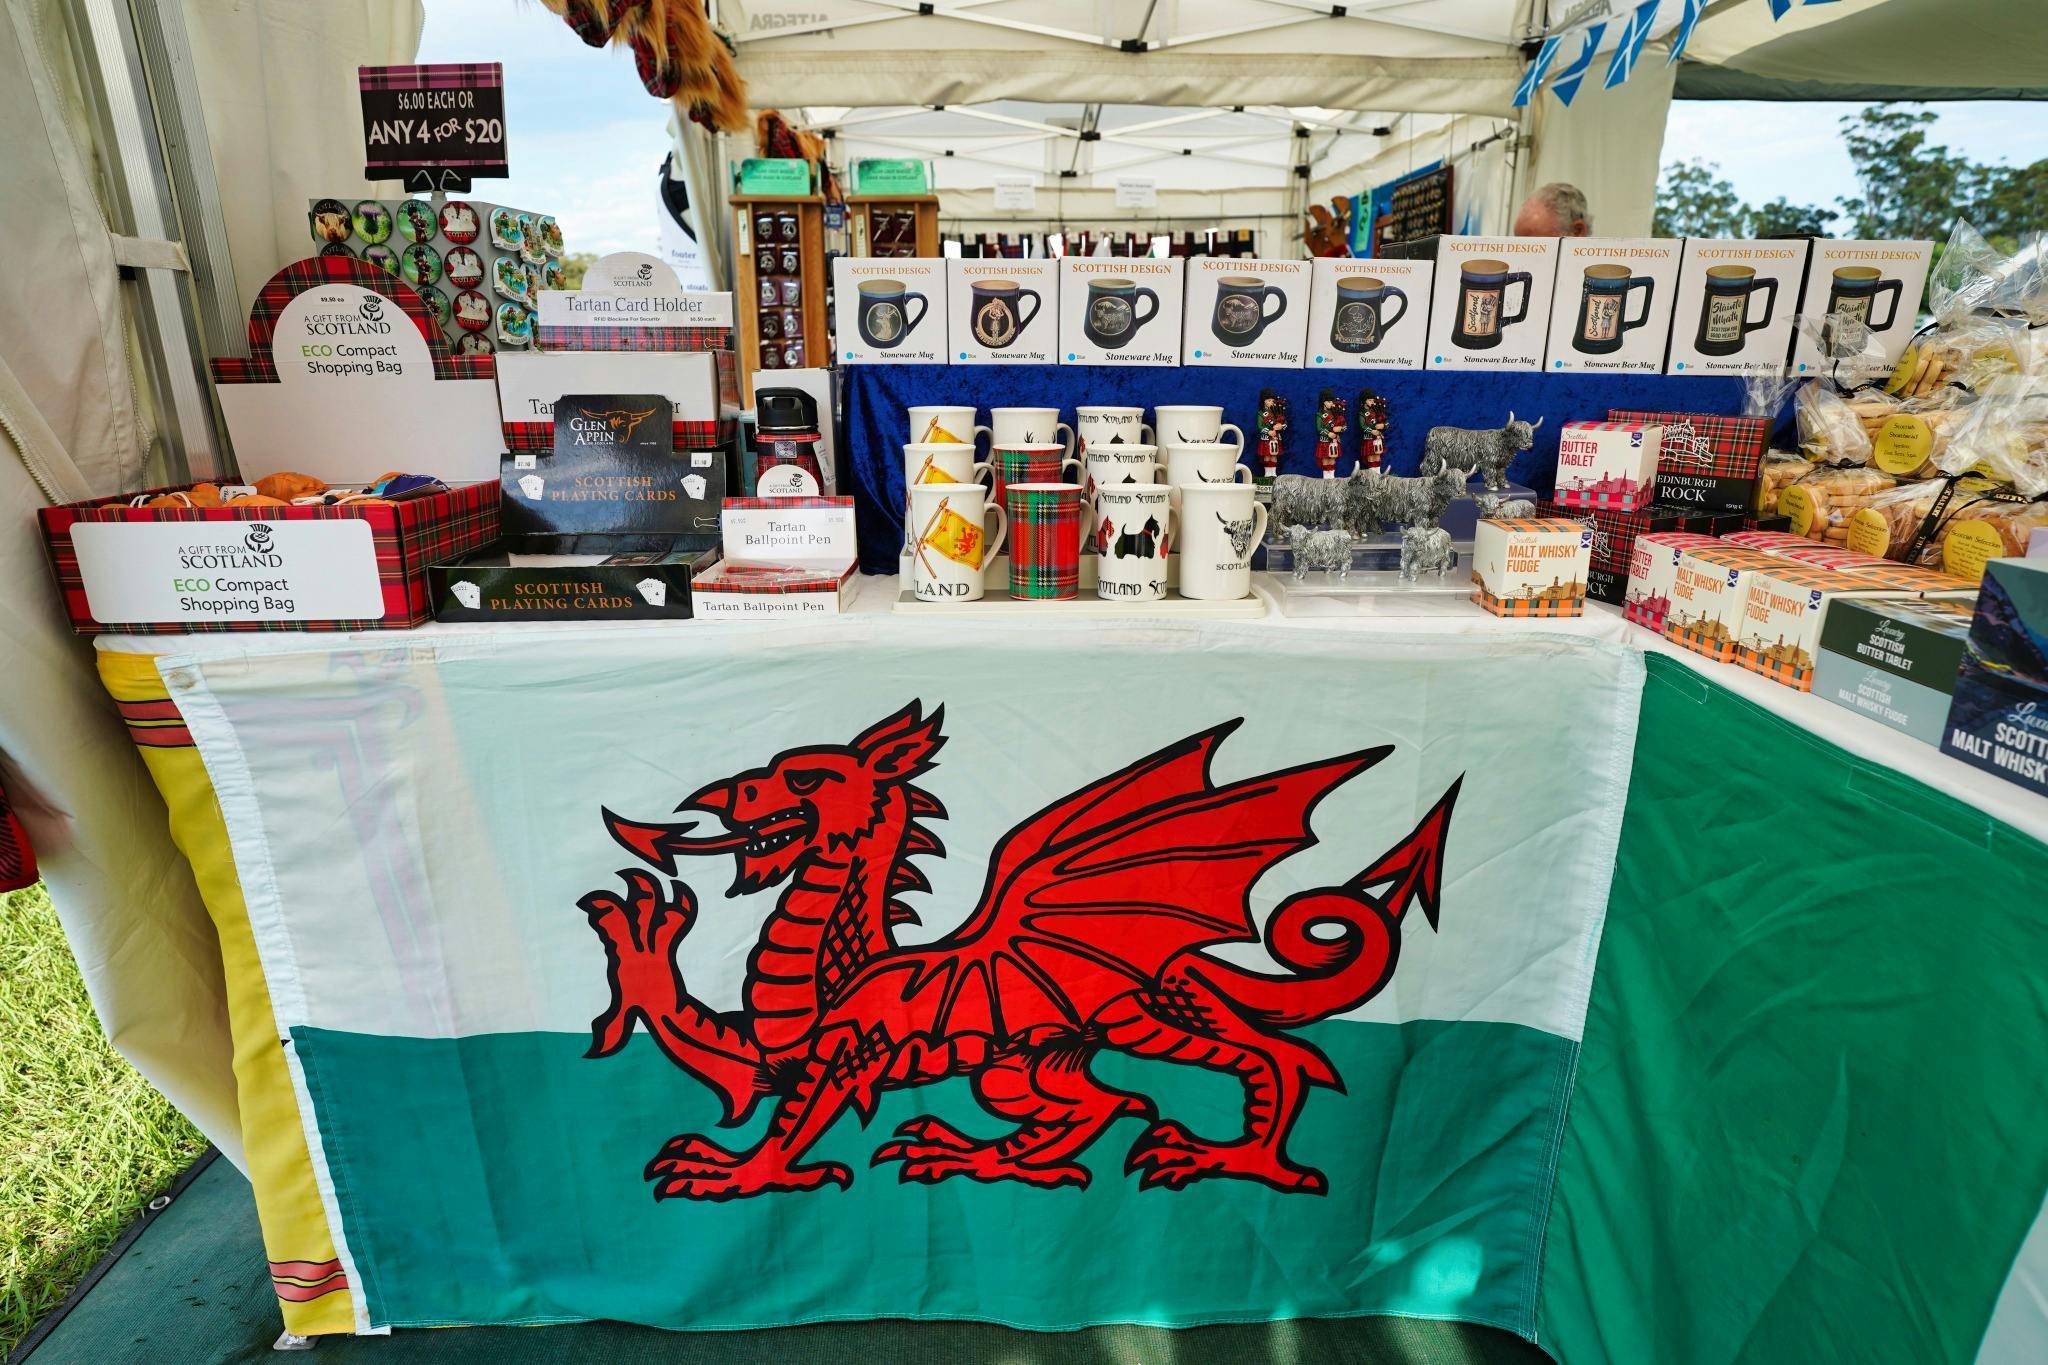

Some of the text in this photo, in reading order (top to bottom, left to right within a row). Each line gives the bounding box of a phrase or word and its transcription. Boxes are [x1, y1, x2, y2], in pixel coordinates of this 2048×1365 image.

[398, 91, 475, 110] $6.00 EACH OR
[368, 117, 502, 145] ANY 4 FOR $20
[1450, 242, 1547, 254] SCOTTISH DESIGN
[1573, 248, 1671, 258] SCOTTISH DESIGN
[1697, 249, 1796, 259] SCOTTISH DESIGN
[1824, 250, 1921, 260] SCOTTISH DESIGN
[851, 267, 931, 275] SCOTTISH DESIGN
[963, 266, 1043, 275] SCOTTISH DESIGN
[1072, 263, 1172, 274] SCOTTISH DESIGN
[1202, 261, 1301, 273] SCOTTISH DESIGN
[1334, 264, 1412, 274] SCOTTISH DESIGN
[565, 296, 703, 312] Tartan Card Holder
[304, 314, 362, 323] A GIFT FROM
[1468, 295, 1480, 332] Scotland
[1590, 299, 1602, 336] Scotland
[306, 322, 391, 336] SCOTLAND
[301, 344, 398, 359] ECO Compact
[880, 351, 934, 360] Stoneware Mug
[1028, 352, 1045, 360] Mug
[1105, 352, 1173, 363] Stoneware Mug
[1230, 350, 1299, 362] Stoneware Mug
[1360, 356, 1413, 366] Stoneware Mug
[1463, 355, 1501, 364] Stoneware
[1501, 356, 1518, 364] Beer
[1519, 356, 1537, 366] Mug
[1584, 361, 1656, 371] Stoneware Beer Mug
[1705, 362, 1743, 370] Stoneware
[1743, 362, 1759, 370] Beer
[307, 361, 403, 376] Shopping Bag
[528, 399, 555, 415] Tar
[570, 417, 607, 432] GLEN
[574, 432, 615, 446] APPIN
[1561, 440, 1598, 454] BUTTER
[1114, 453, 1146, 464] SCOTLAND
[1560, 454, 1595, 467] TABLET
[575, 476, 654, 488] SCOTTISH
[1657, 474, 1717, 488] EDINBURGH
[552, 490, 676, 501] PLAYING CARDS
[1102, 492, 1166, 504] SCOTLAND SCOTLAND
[1661, 486, 1707, 502] ROCK
[768, 521, 806, 532] Tartan
[745, 535, 831, 547] Ballpoint Pen
[178, 546, 248, 555] A GIFT FROM
[1508, 545, 1578, 559] MALT WHISKY
[180, 554, 283, 569] SCOTLAND
[1632, 549, 1653, 567] BUTTER
[1507, 559, 1540, 573] FUDGE
[1631, 563, 1650, 580] TABLET
[1588, 570, 1614, 584] BURGH
[1676, 566, 1725, 595] MALT WHISKY
[173, 577, 290, 594] ECO Compact
[514, 582, 604, 595] SCOTTISH
[914, 580, 970, 597] LAND
[1674, 582, 1695, 601] FUDGE
[180, 596, 295, 615] Shopping Bag
[491, 596, 633, 610] PLAYING CARDS
[703, 602, 825, 614] Tartan Ballpoint Pen
[1750, 586, 1805, 618] MALT WHISKY
[1746, 603, 1769, 624] FUDGE
[1874, 619, 1906, 640] Luxury
[1869, 634, 1905, 654] SCOTTISH
[1857, 642, 1913, 671] BUTTER TABLET
[1863, 670, 1892, 691] Luxury
[1857, 684, 1892, 704] SCOTTISH
[1838, 688, 1909, 726] MALT WHISKY FUDGE
[1994, 722, 2048, 761] SCOTT
[1951, 728, 2048, 784] MALT WHISK
